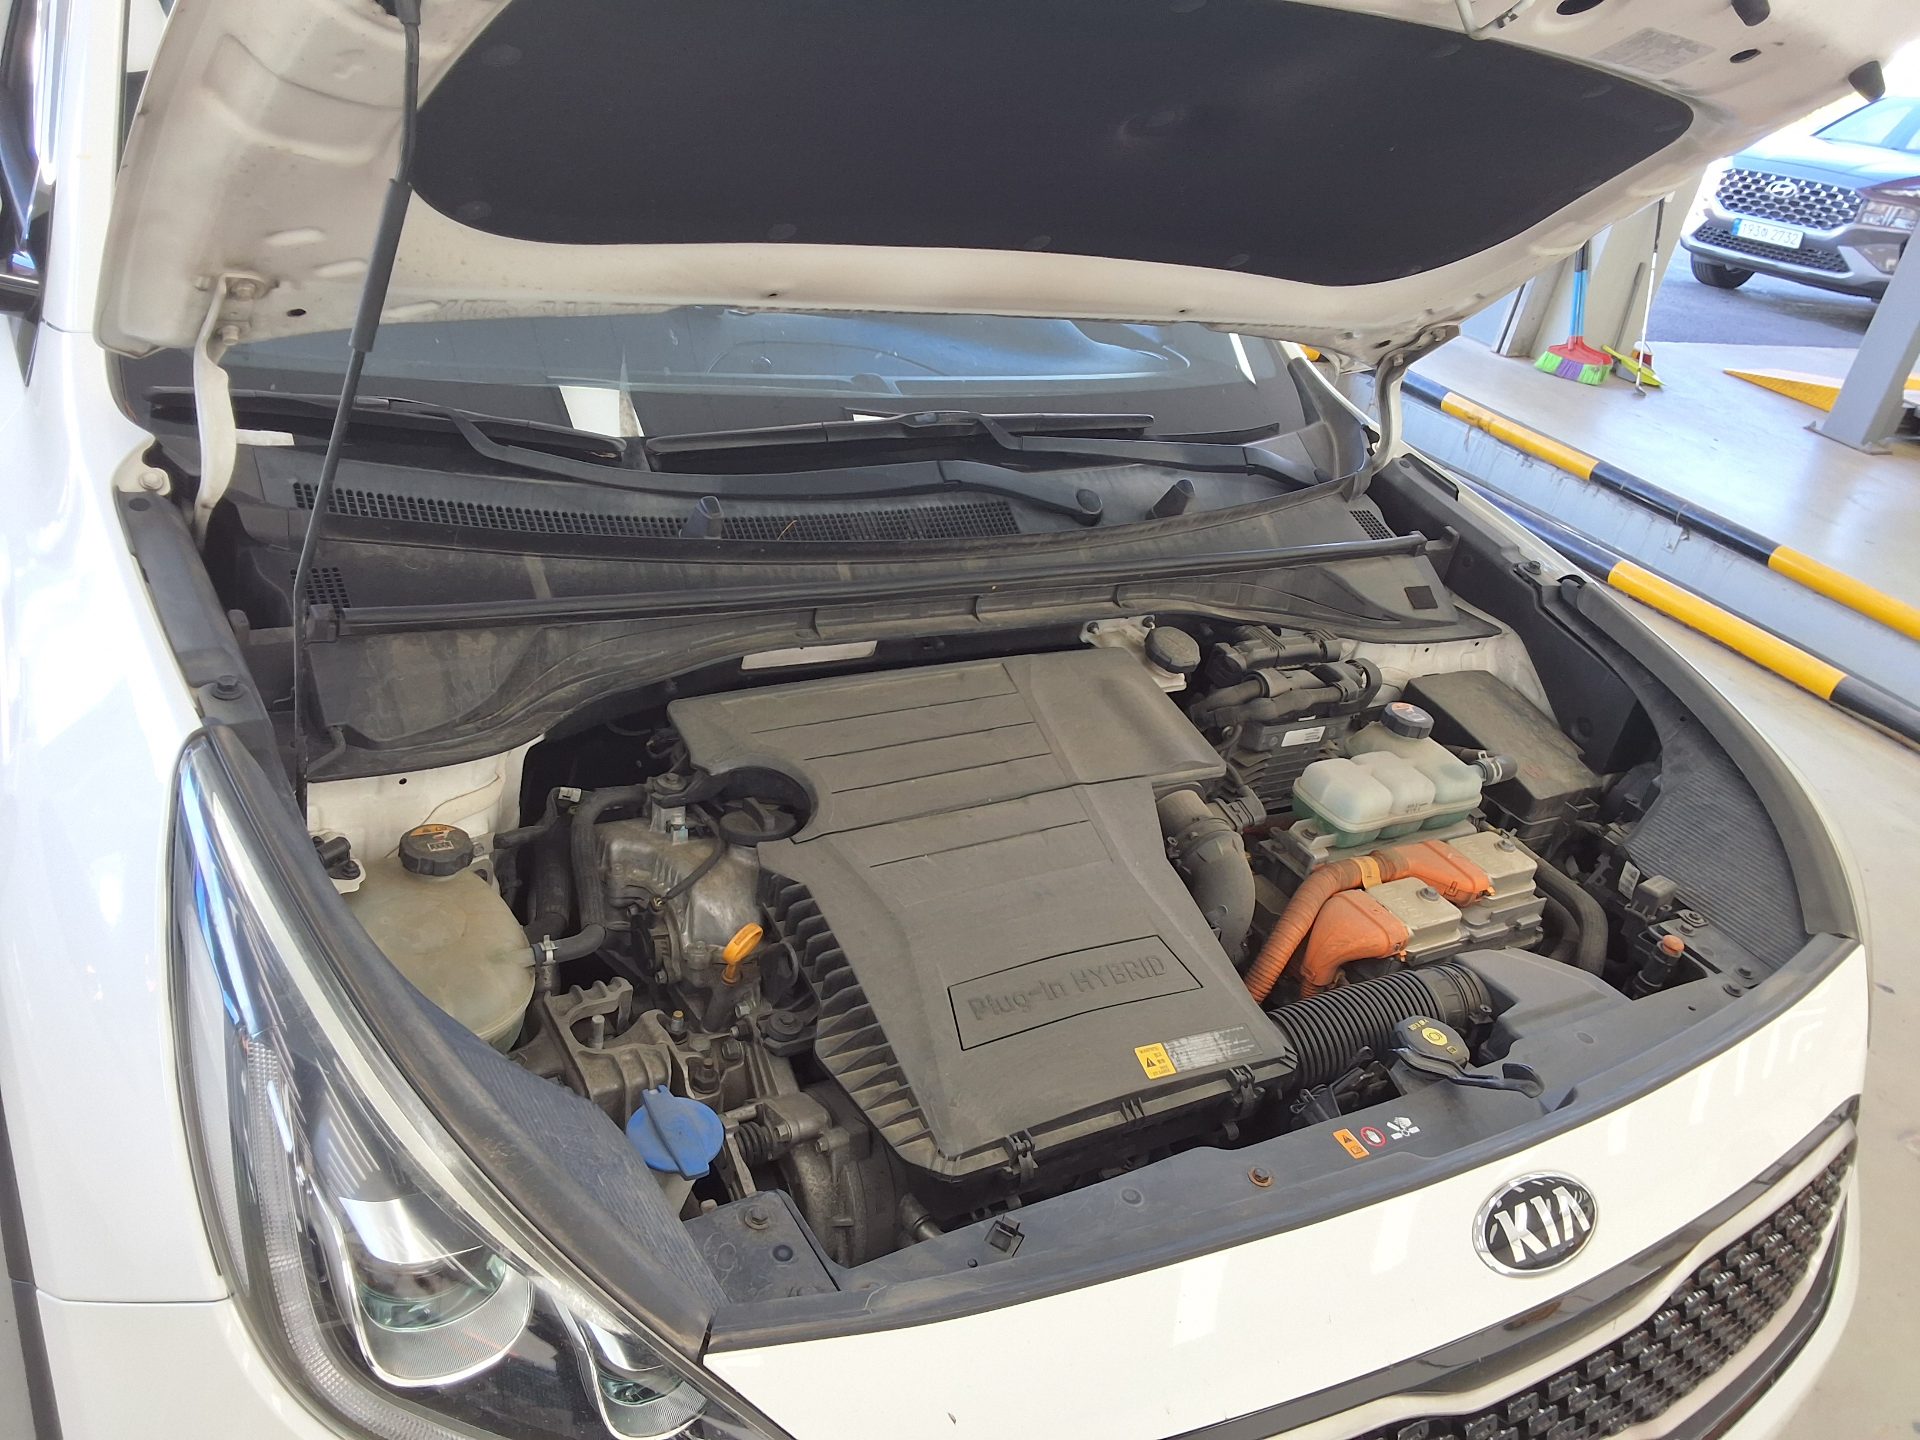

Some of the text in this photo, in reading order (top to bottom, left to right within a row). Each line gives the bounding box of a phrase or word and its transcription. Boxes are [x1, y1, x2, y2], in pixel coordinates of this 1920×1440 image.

[1771, 229, 1799, 246] 2732
[1070, 954, 1168, 993] HYBRID
[1494, 1186, 1591, 1263] KIA
